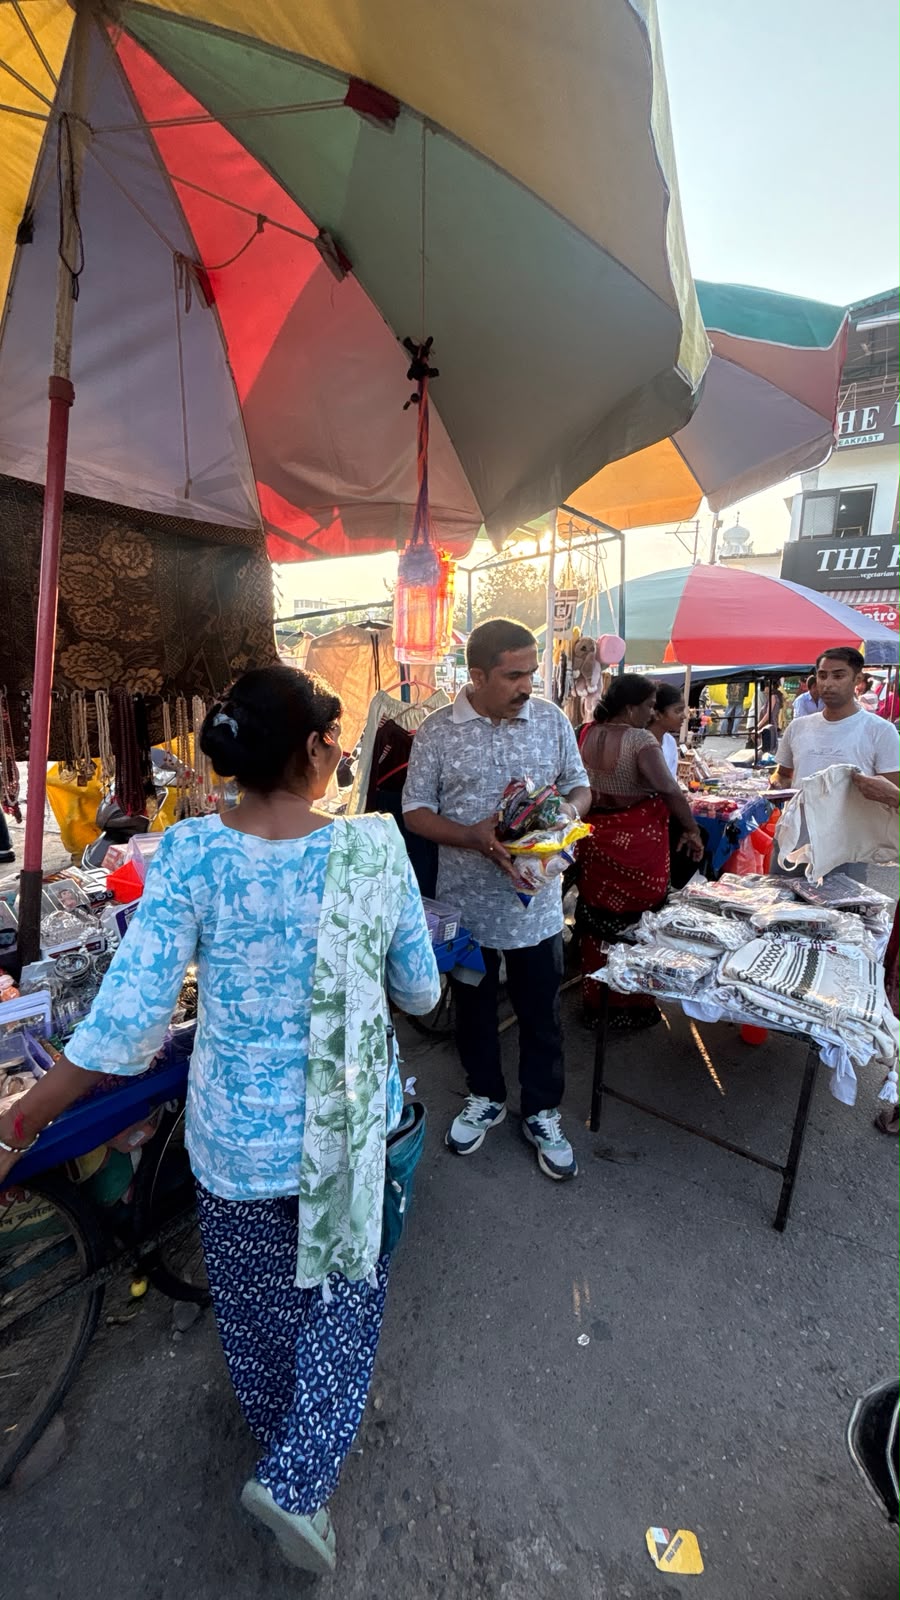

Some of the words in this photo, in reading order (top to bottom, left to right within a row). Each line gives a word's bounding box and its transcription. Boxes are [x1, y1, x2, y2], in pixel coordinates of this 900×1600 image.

[838, 406, 880, 435] HE
[838, 435, 880, 446] EAKFAST
[816, 546, 881, 572] THE
[860, 571, 895, 580] vegetarian
[856, 610, 897, 622] etro
